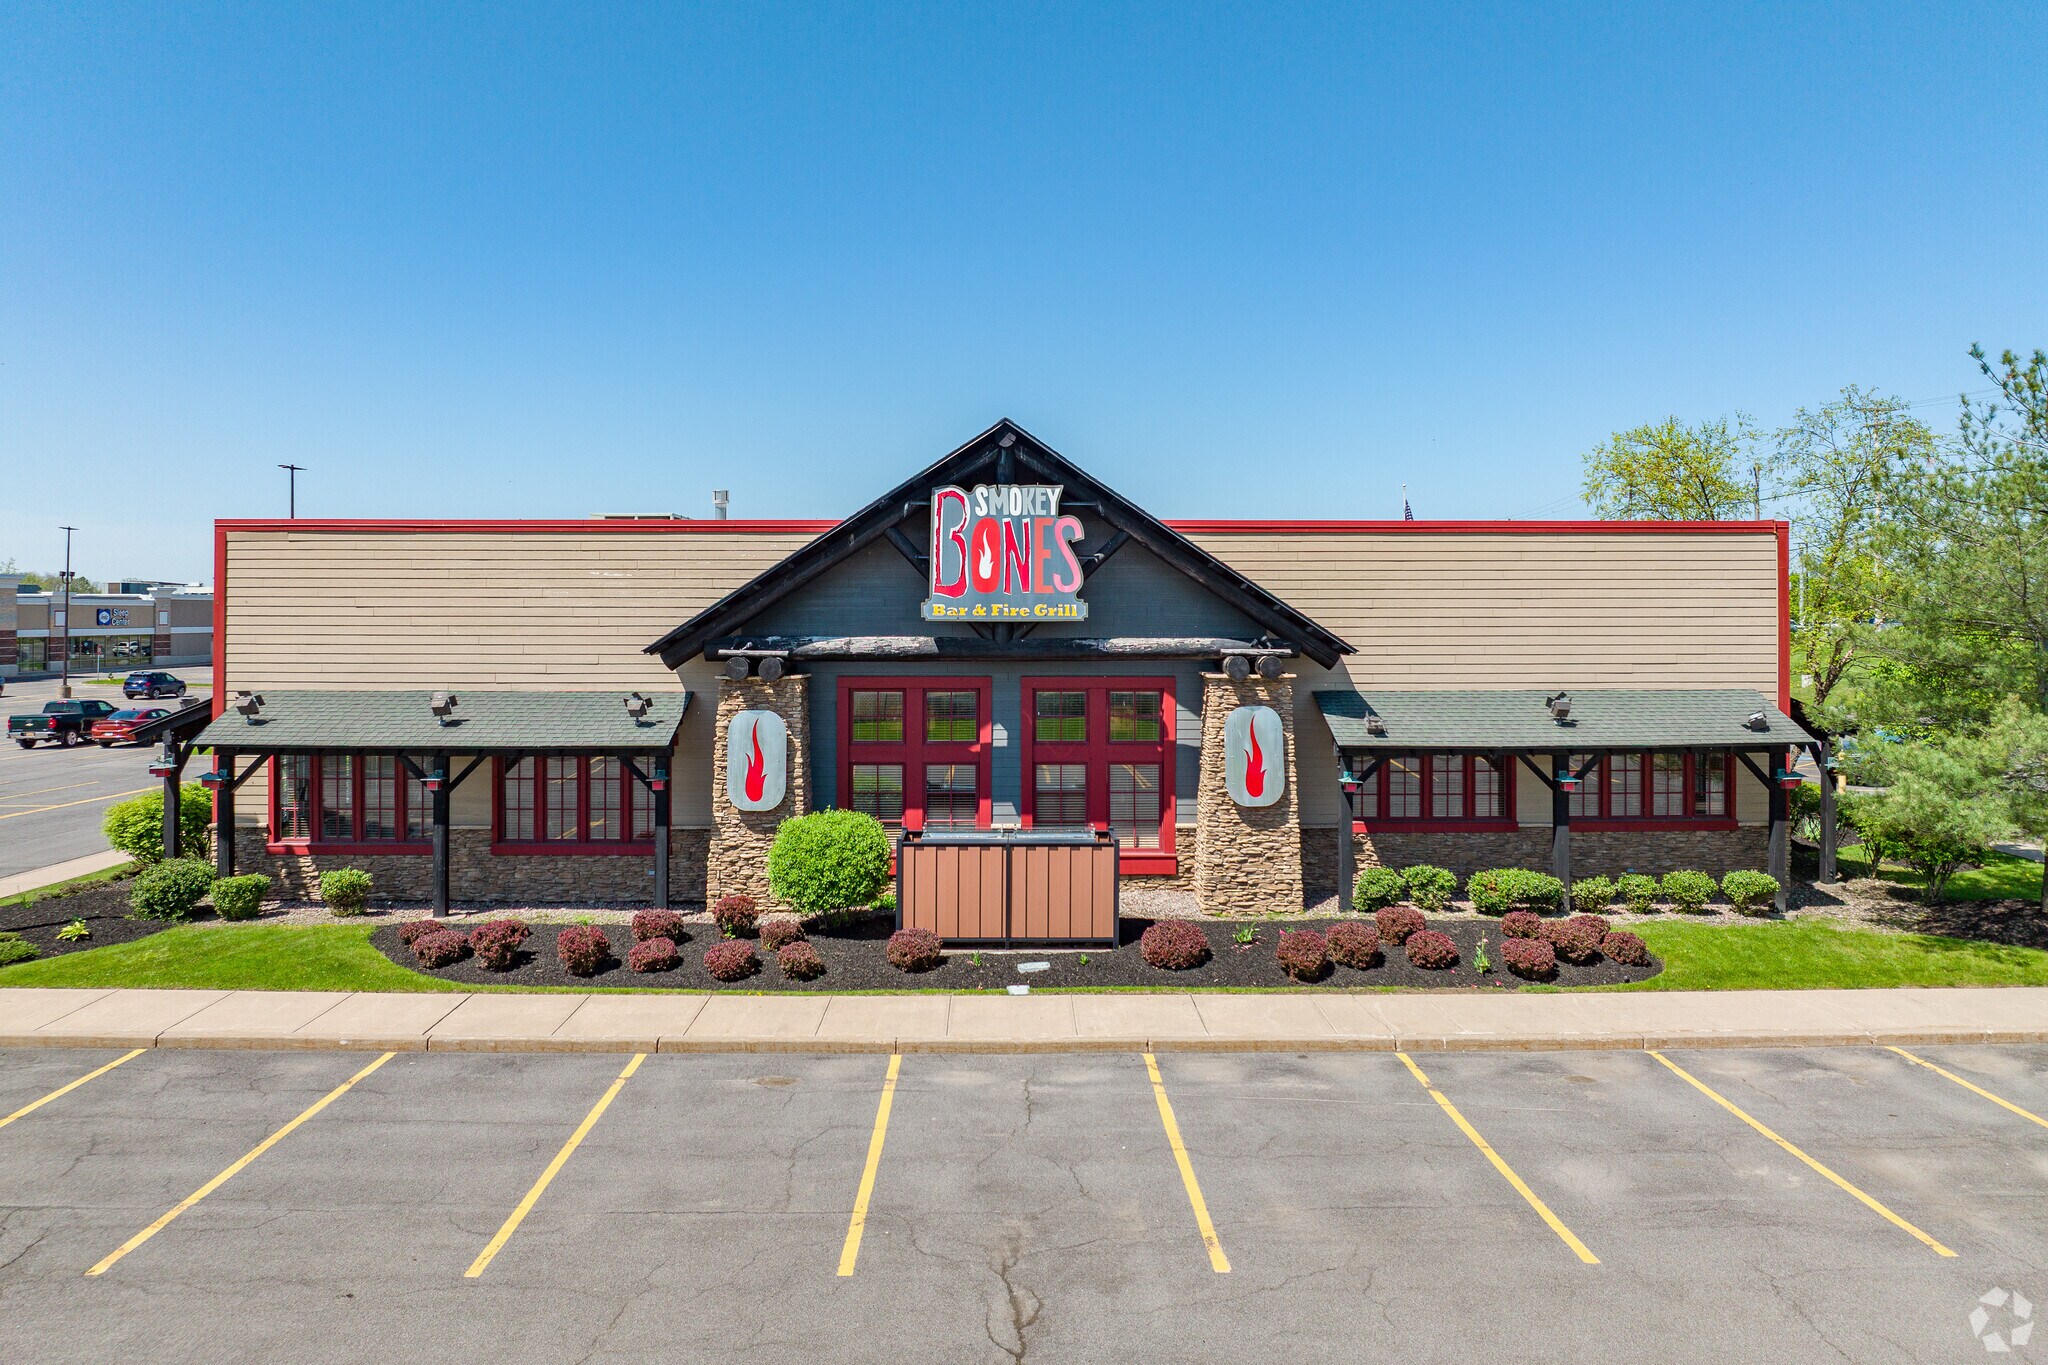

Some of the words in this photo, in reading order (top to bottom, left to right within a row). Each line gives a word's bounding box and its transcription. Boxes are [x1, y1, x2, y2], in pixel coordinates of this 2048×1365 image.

[975, 487, 1060, 516] SMOKEY
[933, 488, 1082, 598] BONES
[932, 604, 968, 616] Bar
[972, 604, 987, 616] &
[991, 604, 1030, 616] Fire
[1034, 604, 1078, 616] Grill
[111, 618, 130, 626] Center
